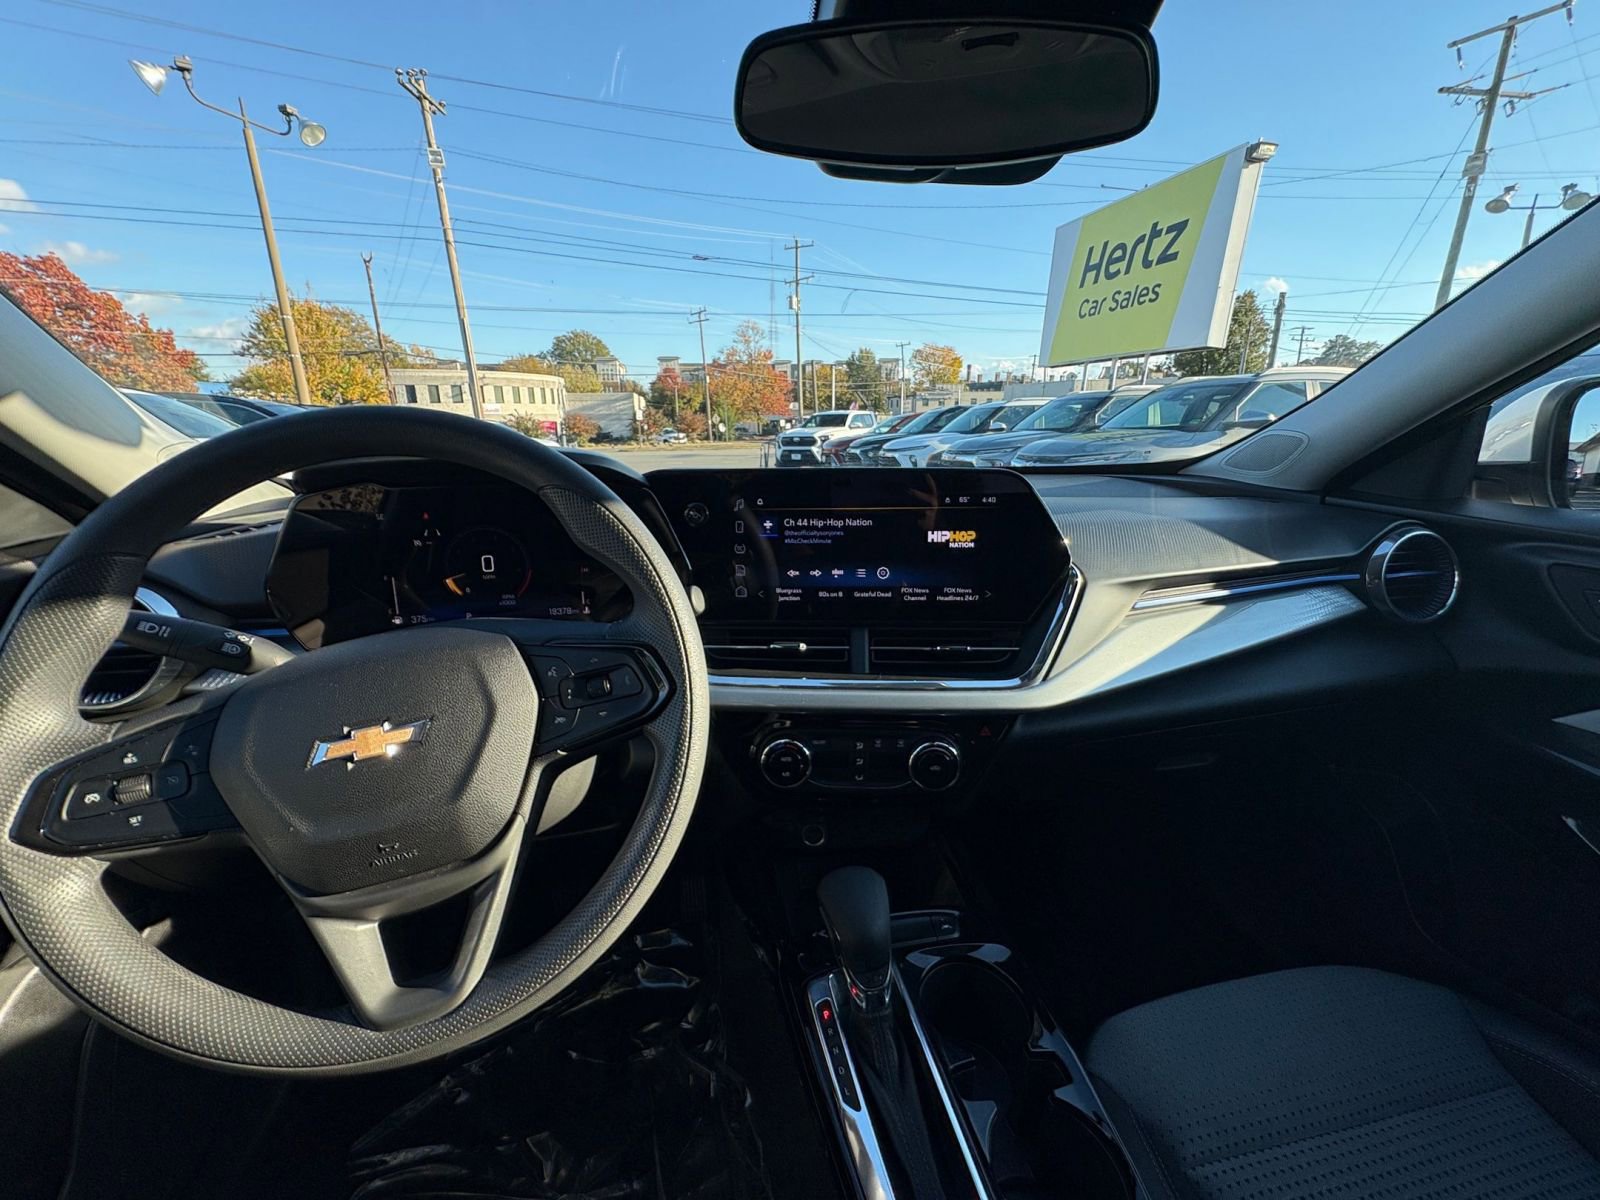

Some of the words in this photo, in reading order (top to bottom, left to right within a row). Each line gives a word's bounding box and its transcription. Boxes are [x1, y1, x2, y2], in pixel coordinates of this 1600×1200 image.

[1079, 218, 1190, 289] Hertz
[1078, 296, 1107, 319] Car
[1109, 282, 1162, 313] Sales
[783, 518, 795, 527] Ch
[796, 518, 808, 527] 44
[809, 518, 844, 528] Hip-Hop
[845, 518, 873, 527] Nation
[481, 554, 495, 573] 0
[775, 587, 802, 595] Bluegrass
[822, 1010, 830, 1020] P
[827, 1027, 834, 1036] R
[838, 1066, 845, 1075] D
